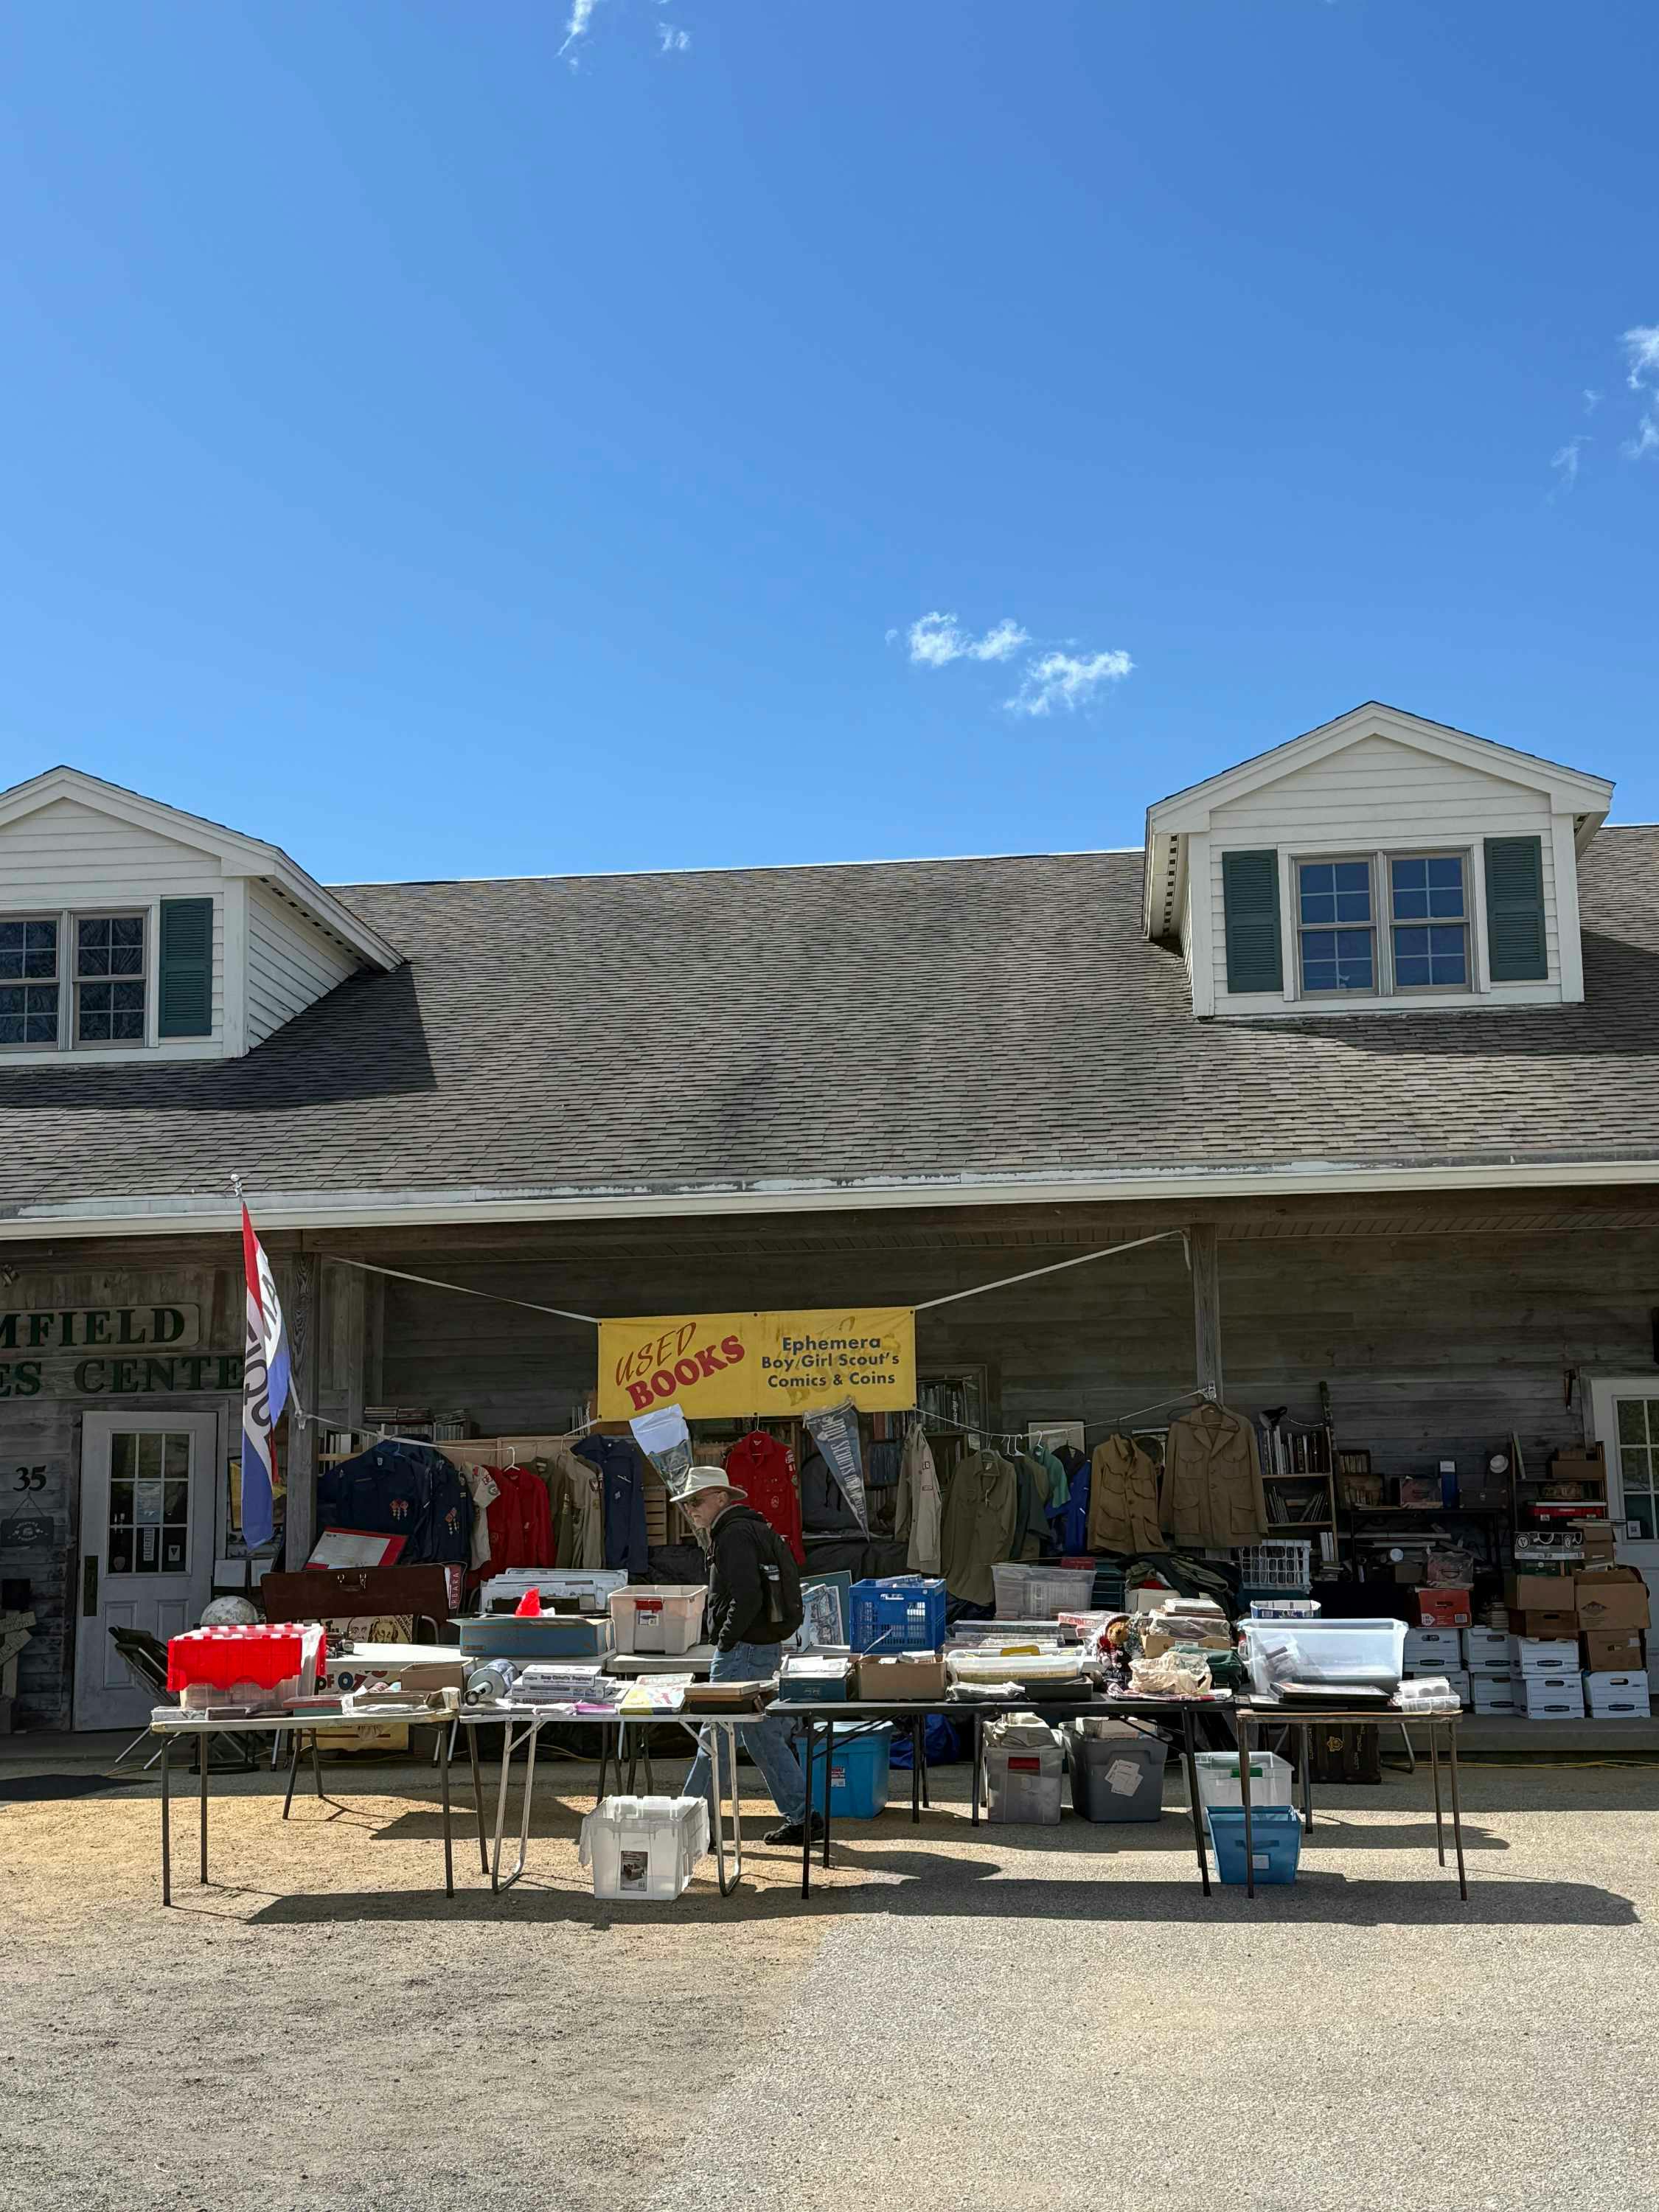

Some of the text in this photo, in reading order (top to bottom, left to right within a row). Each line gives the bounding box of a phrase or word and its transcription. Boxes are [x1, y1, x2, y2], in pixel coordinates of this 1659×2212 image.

[616, 1322, 696, 1385] USED
[782, 1335, 880, 1355] Ephemera
[74, 1355, 244, 1394] CENTE
[625, 1335, 745, 1411] BOOKS
[762, 1352, 900, 1371] Boy/Girl Scout's
[768, 1371, 895, 1387] Comics & Coins
[830, 1439, 856, 1476] SCOUTS
[13, 1465, 46, 1492] 35
